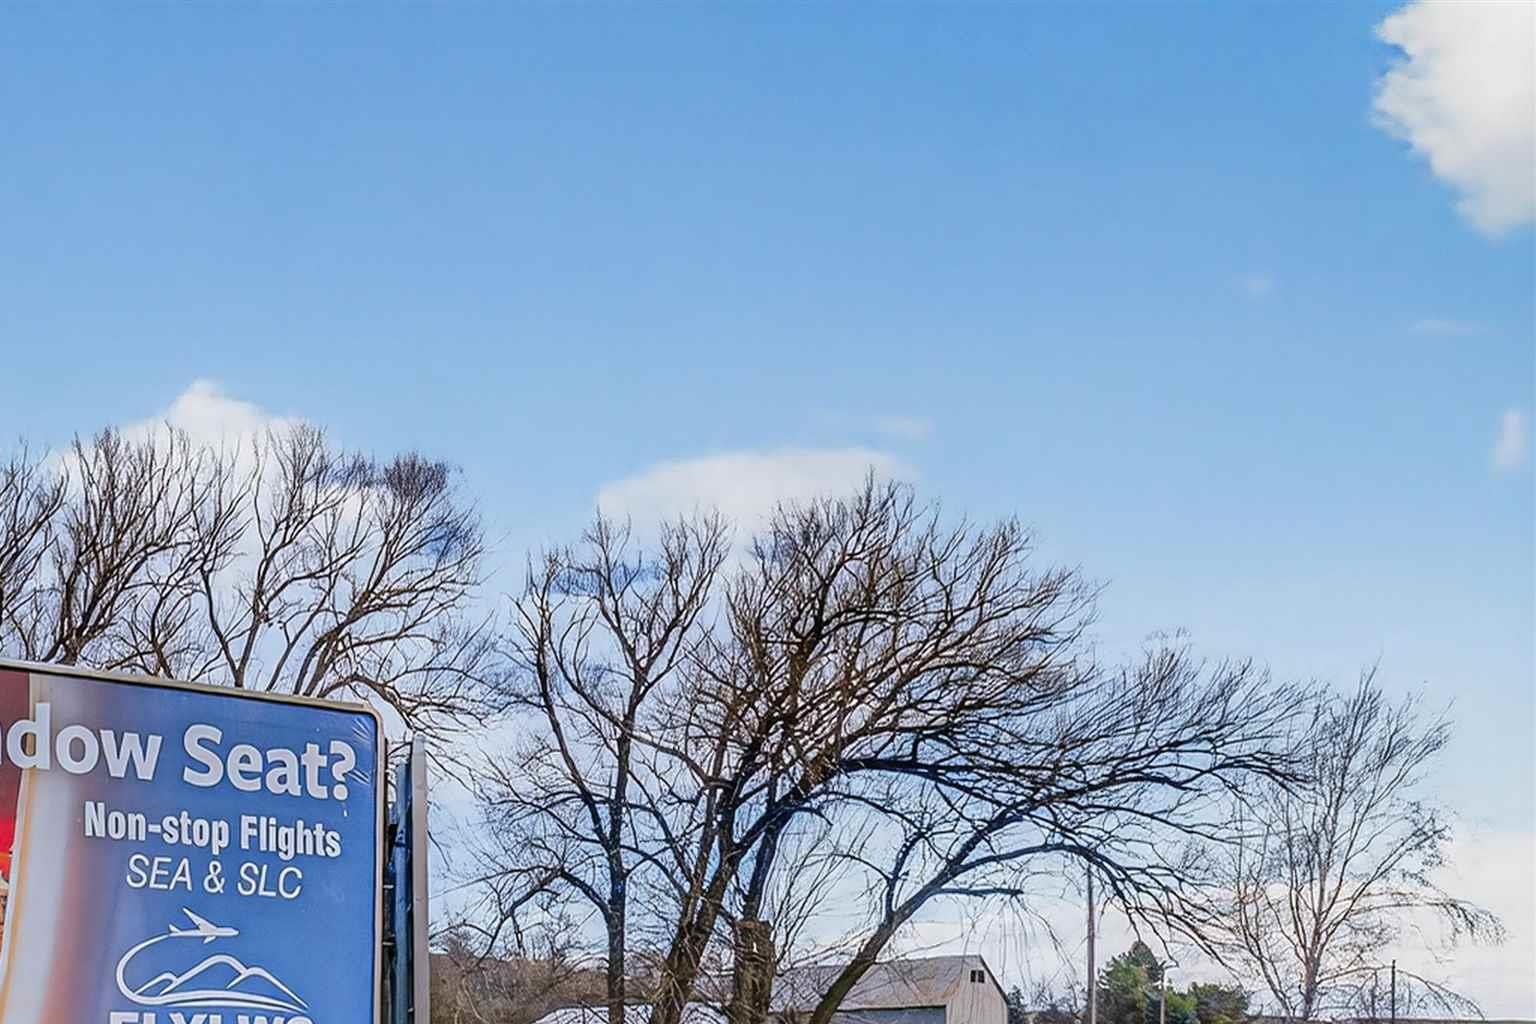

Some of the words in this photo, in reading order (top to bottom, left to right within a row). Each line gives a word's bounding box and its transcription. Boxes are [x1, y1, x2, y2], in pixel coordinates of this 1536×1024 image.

[182, 724, 356, 801] Seat?
[84, 801, 230, 855] Non-stop
[240, 815, 342, 860] Flights
[126, 854, 193, 891] SEA
[203, 860, 226, 894] &
[237, 861, 303, 899] SLC
